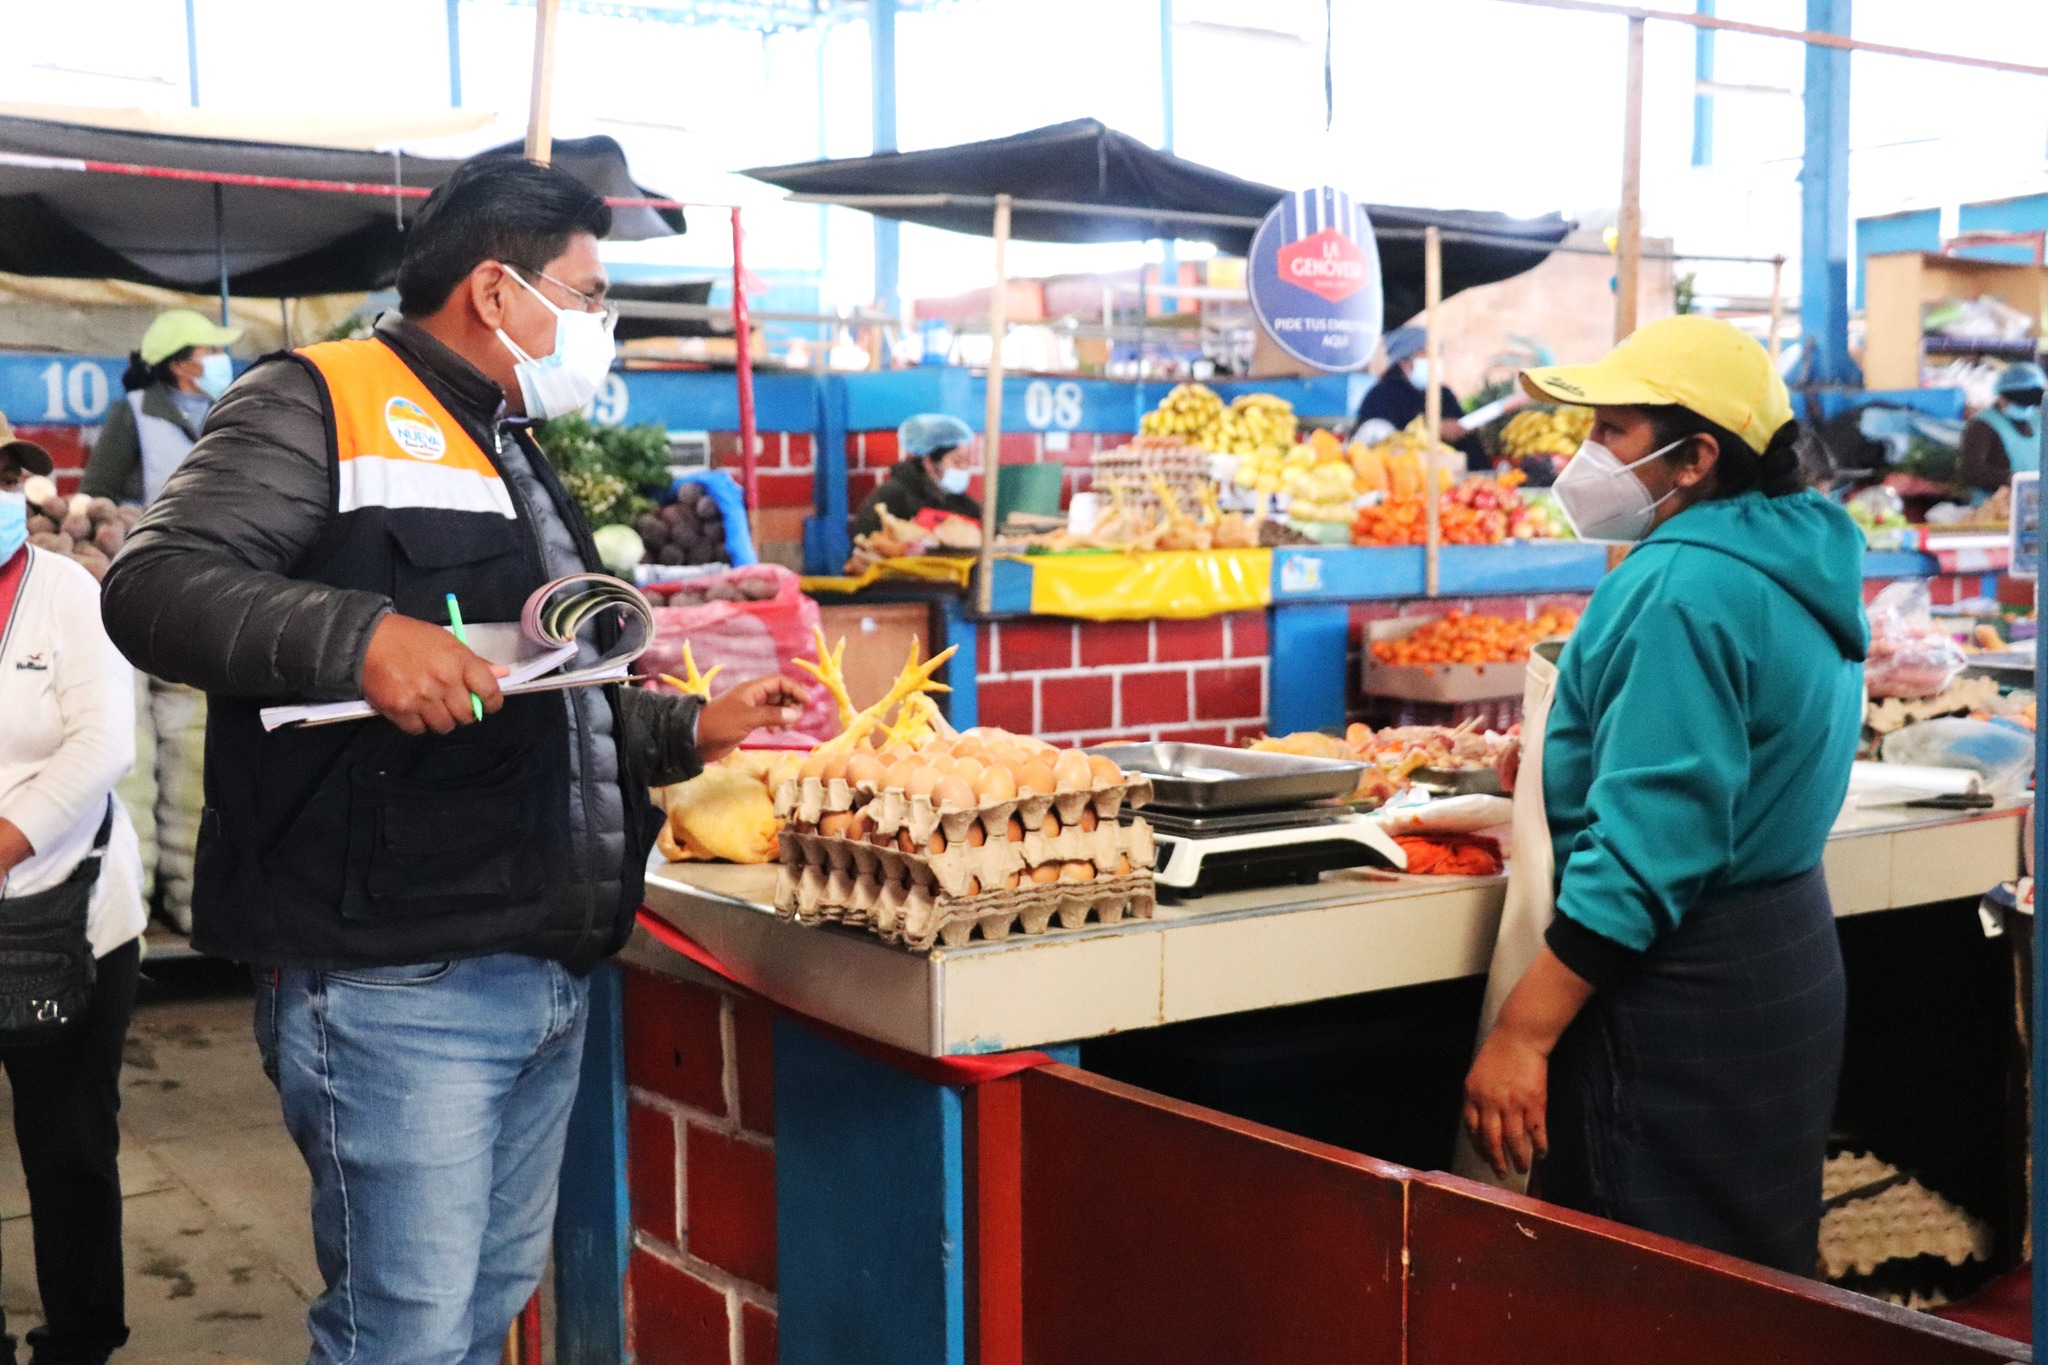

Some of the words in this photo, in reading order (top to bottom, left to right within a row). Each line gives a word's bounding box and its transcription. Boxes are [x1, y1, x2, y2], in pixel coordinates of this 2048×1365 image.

[1322, 240, 1340, 258] LA
[1274, 317, 1302, 332] PIDE
[1304, 317, 1327, 332] TUS
[40, 361, 109, 420] 10
[581, 371, 630, 427] 9
[1024, 379, 1083, 430] 08
[397, 427, 442, 447] NUEVA
